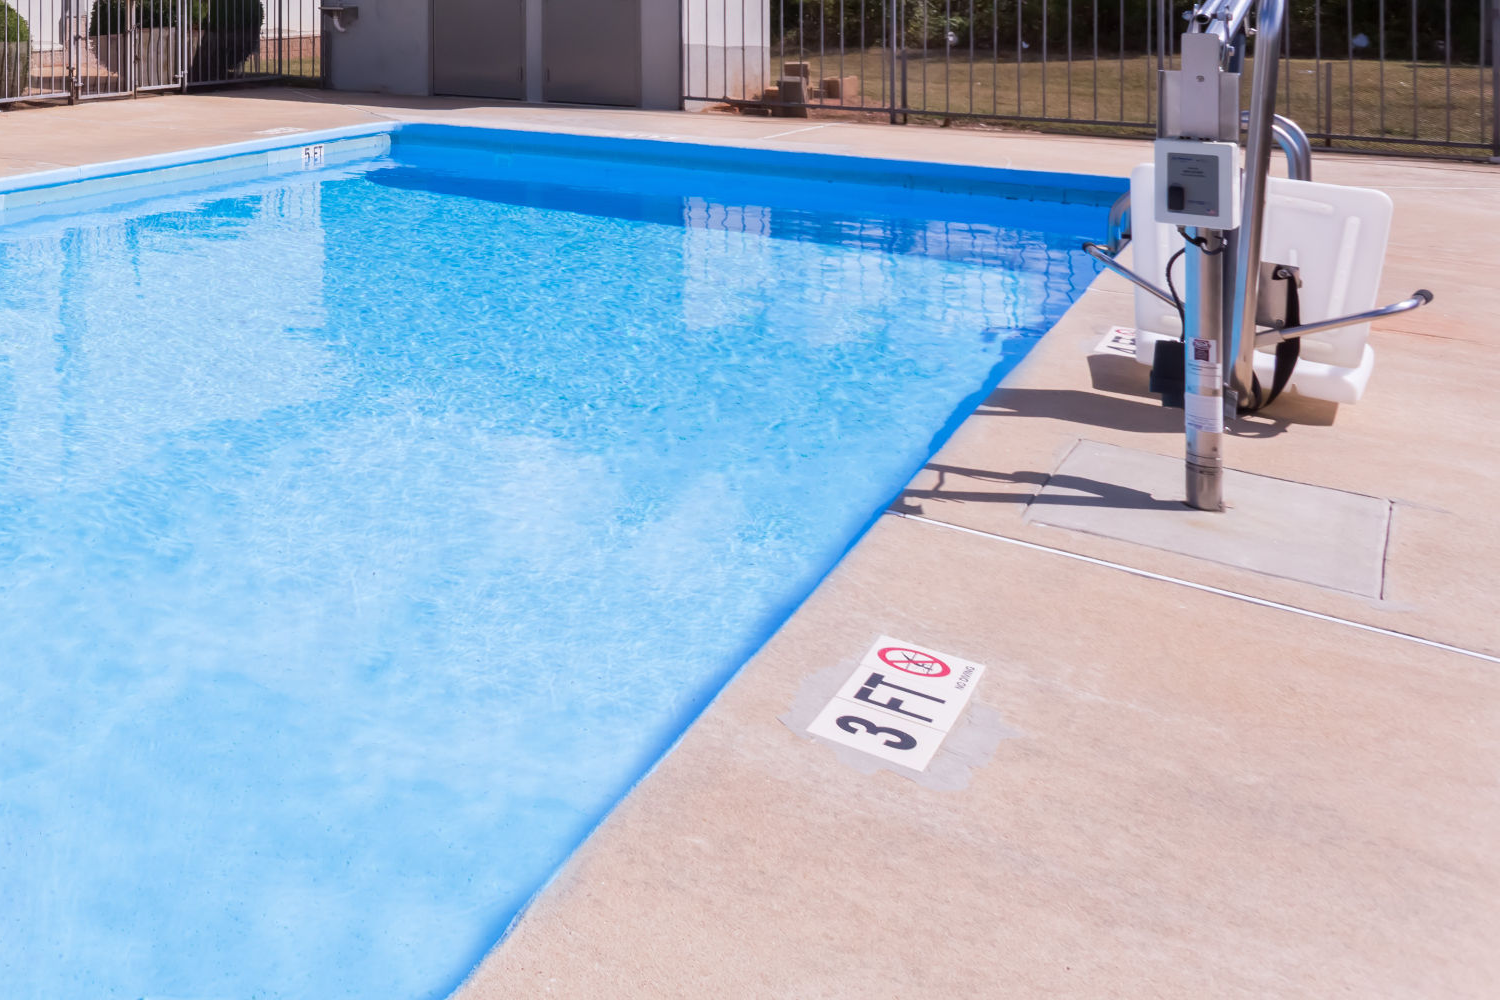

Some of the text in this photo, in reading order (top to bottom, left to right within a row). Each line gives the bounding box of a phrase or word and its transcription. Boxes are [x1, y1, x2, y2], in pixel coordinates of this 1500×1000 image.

[959, 665, 975, 682] DIVING
[835, 672, 946, 751] 3 FT
